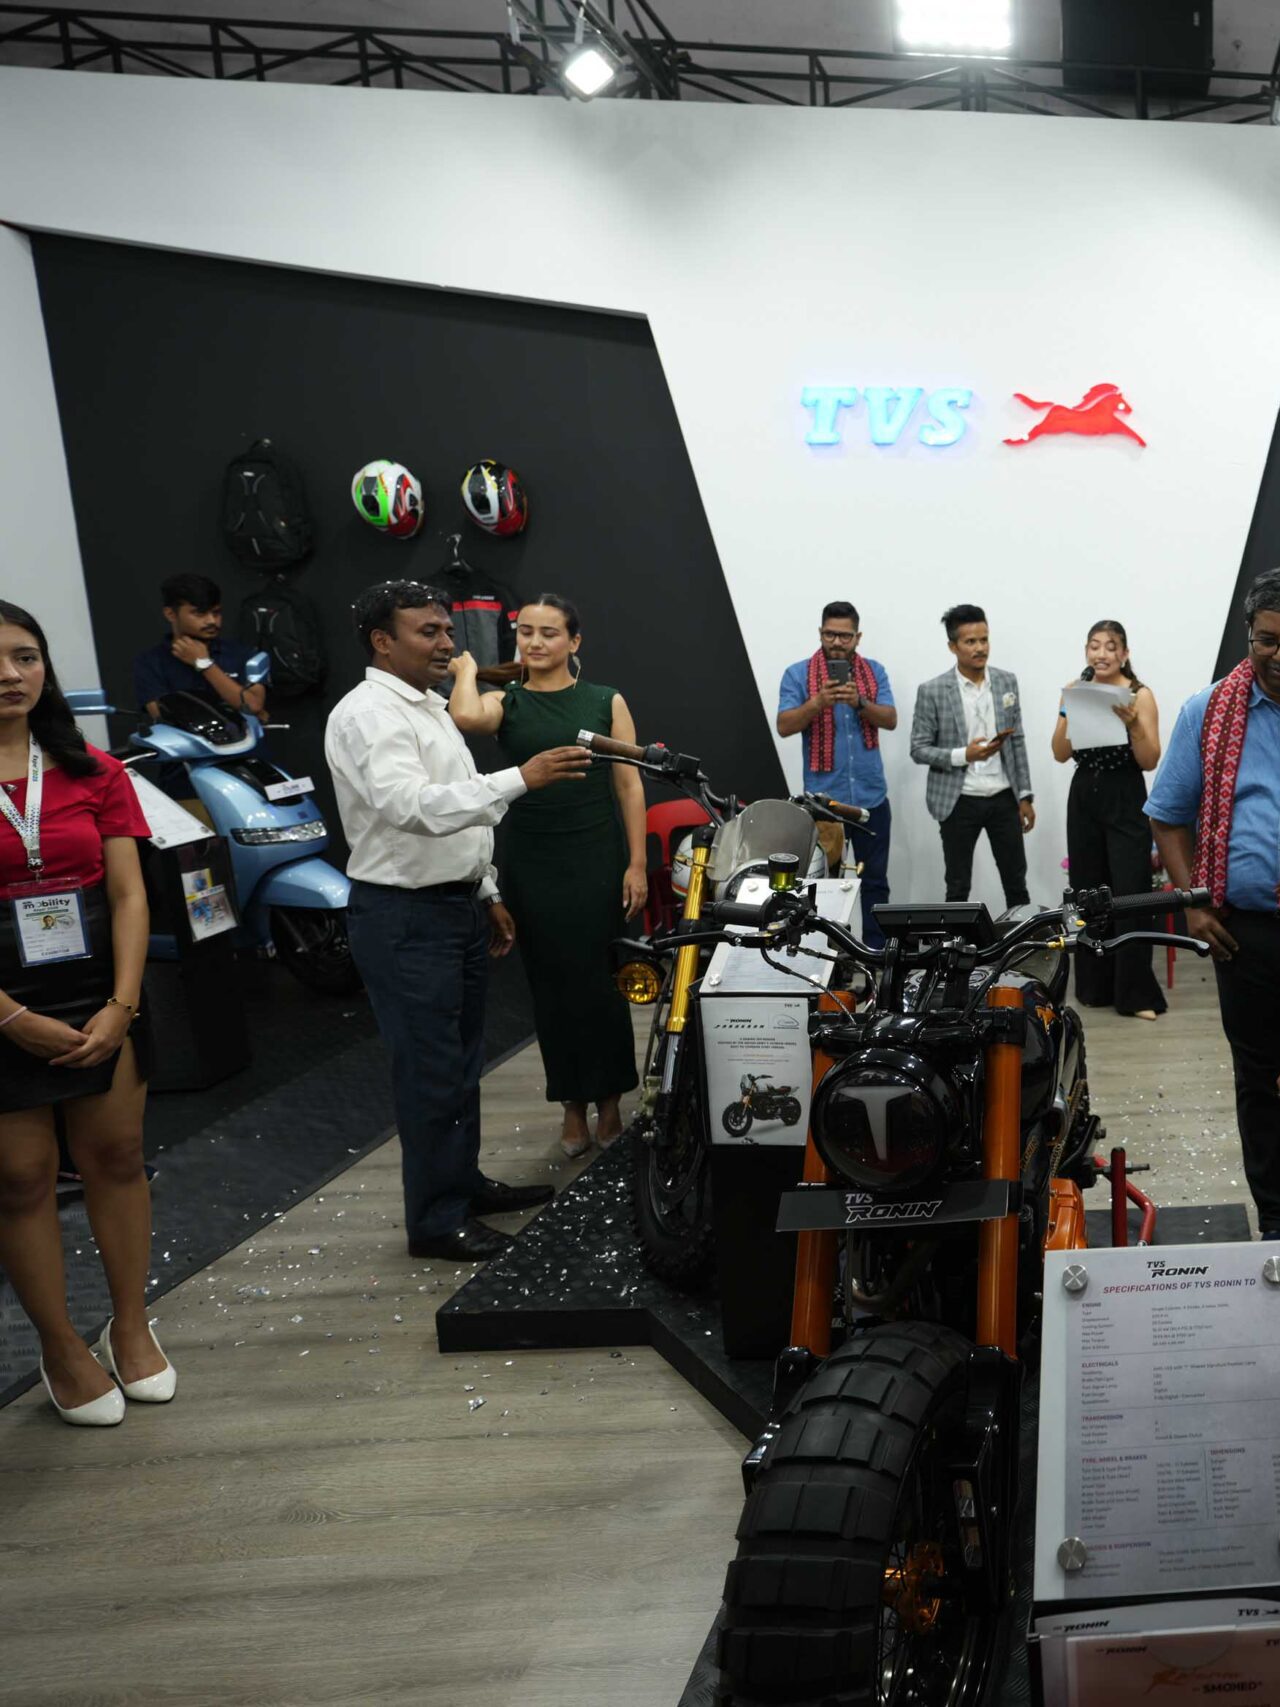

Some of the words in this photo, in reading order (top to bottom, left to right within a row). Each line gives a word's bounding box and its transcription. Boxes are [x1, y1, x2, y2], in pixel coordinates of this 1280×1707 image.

[801, 387, 974, 447] TVS
[845, 1193, 873, 1204] TVS
[845, 1200, 943, 1223] RONIN
[1147, 1261, 1166, 1269] TVS
[1151, 1266, 1209, 1278] RONIN
[1103, 1282, 1178, 1294] SPECIFICATIONS
[1180, 1281, 1192, 1290] OF
[1194, 1280, 1212, 1289] TVS
[1213, 1279, 1243, 1288] RONIN
[1065, 1620, 1110, 1632] RONIN
